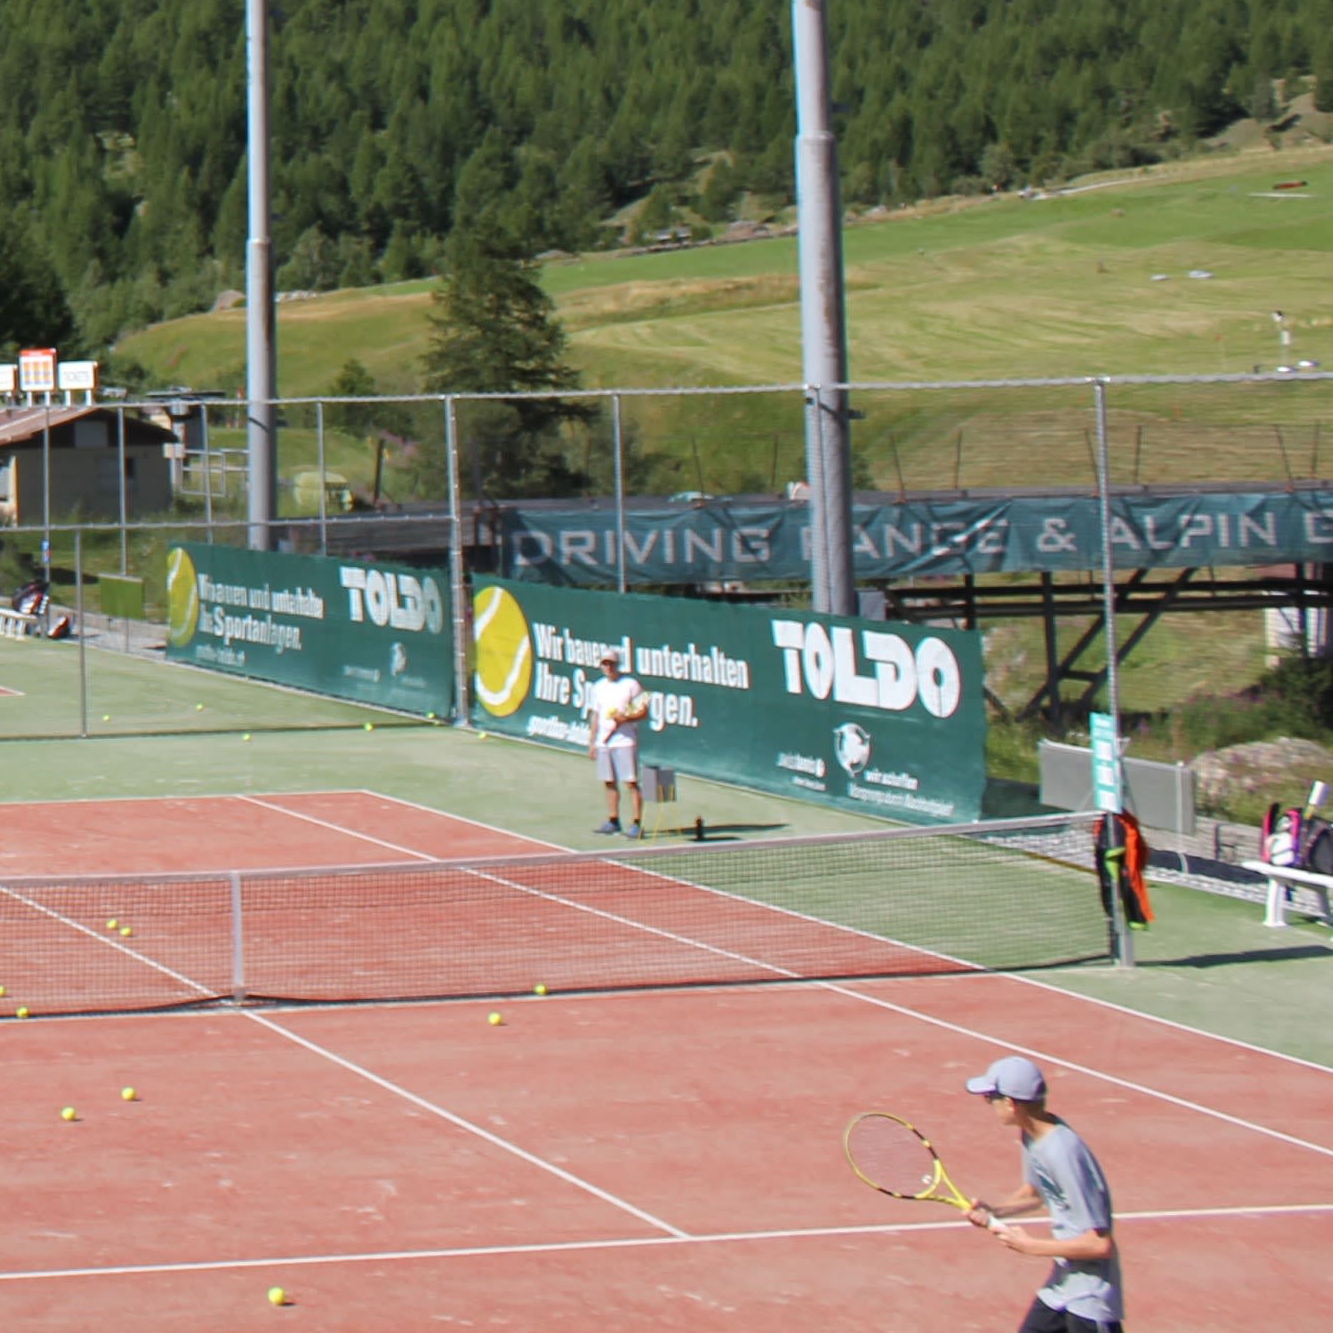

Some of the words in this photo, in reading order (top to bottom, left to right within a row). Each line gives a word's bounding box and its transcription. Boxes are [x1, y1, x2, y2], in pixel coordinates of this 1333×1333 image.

[512, 527, 771, 566] DRIVING
[1036, 517, 1078, 553] &
[1108, 512, 1277, 551] ALPIN
[339, 566, 443, 635] TOLDO
[533, 622, 564, 661] Wir
[636, 643, 749, 689] unterhalten
[534, 661, 571, 705] Ihre
[771, 619, 961, 719] TOLDO
